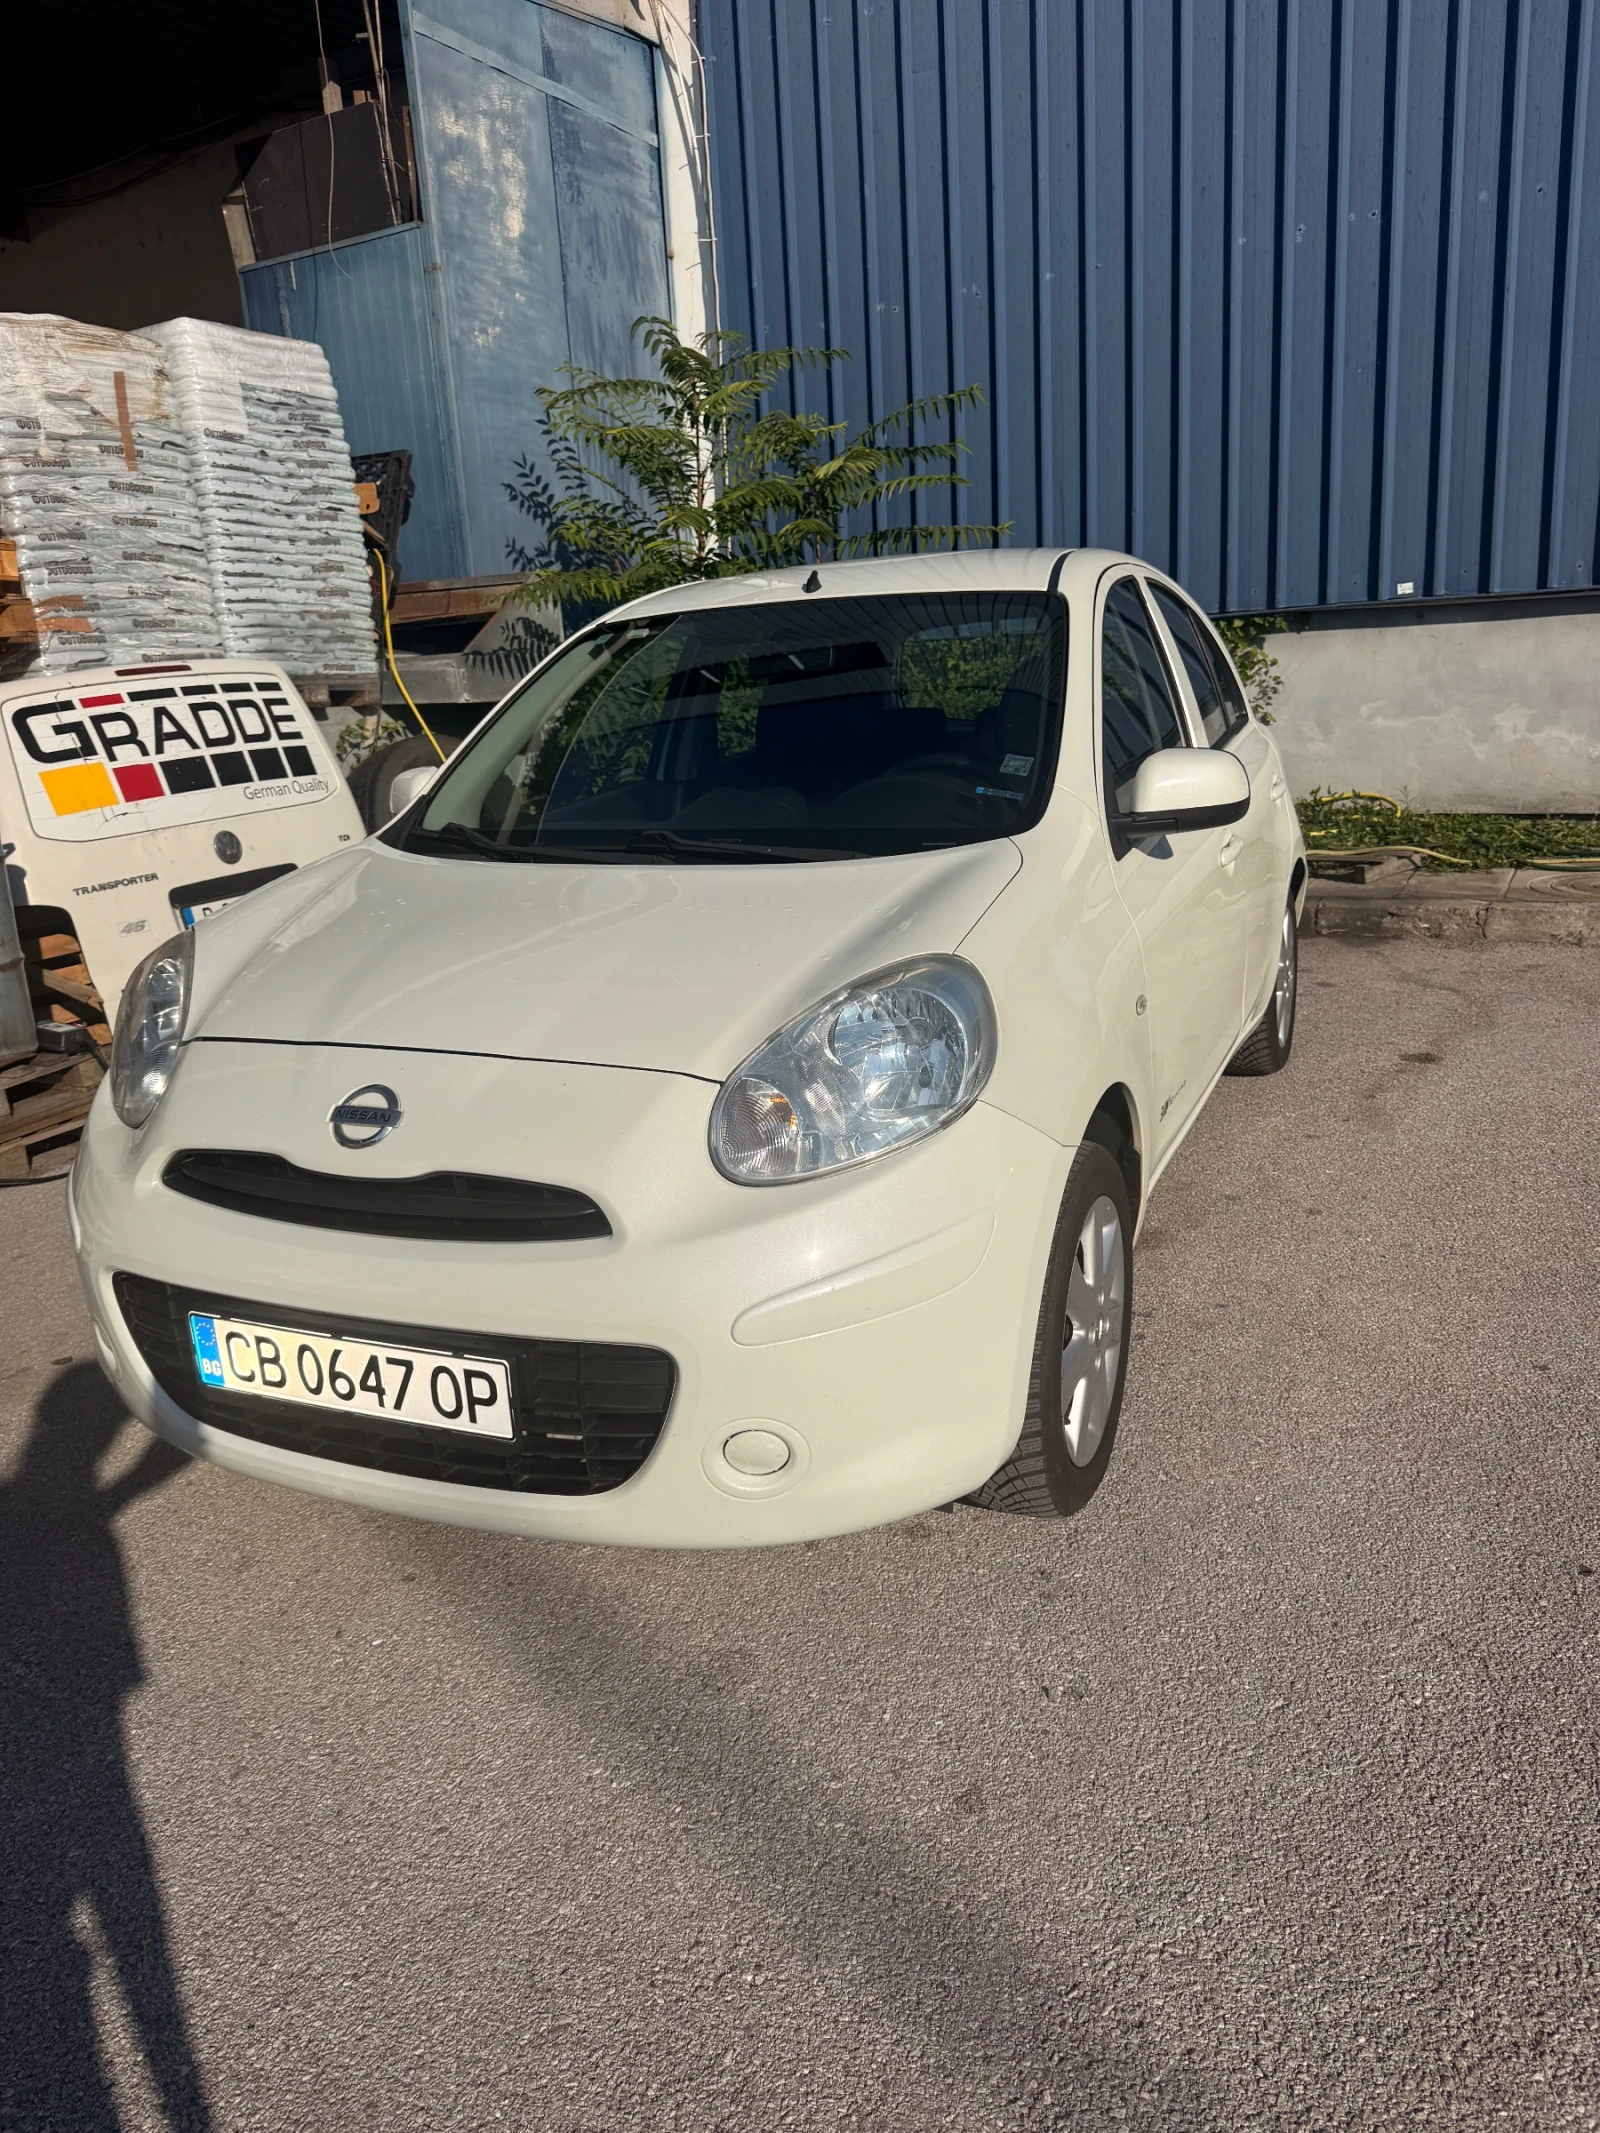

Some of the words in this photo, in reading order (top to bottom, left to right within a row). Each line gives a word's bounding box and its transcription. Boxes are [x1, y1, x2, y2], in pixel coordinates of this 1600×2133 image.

[12, 697, 304, 764] GRADDE
[243, 784, 291, 800] German
[292, 778, 329, 794] Quality
[72, 872, 159, 896] TRANSPORTER
[334, 1108, 392, 1123] NISSAN
[202, 1358, 222, 1376] BG
[225, 1330, 287, 1389] CB
[297, 1343, 415, 1411] 0647
[430, 1365, 498, 1424] OP
